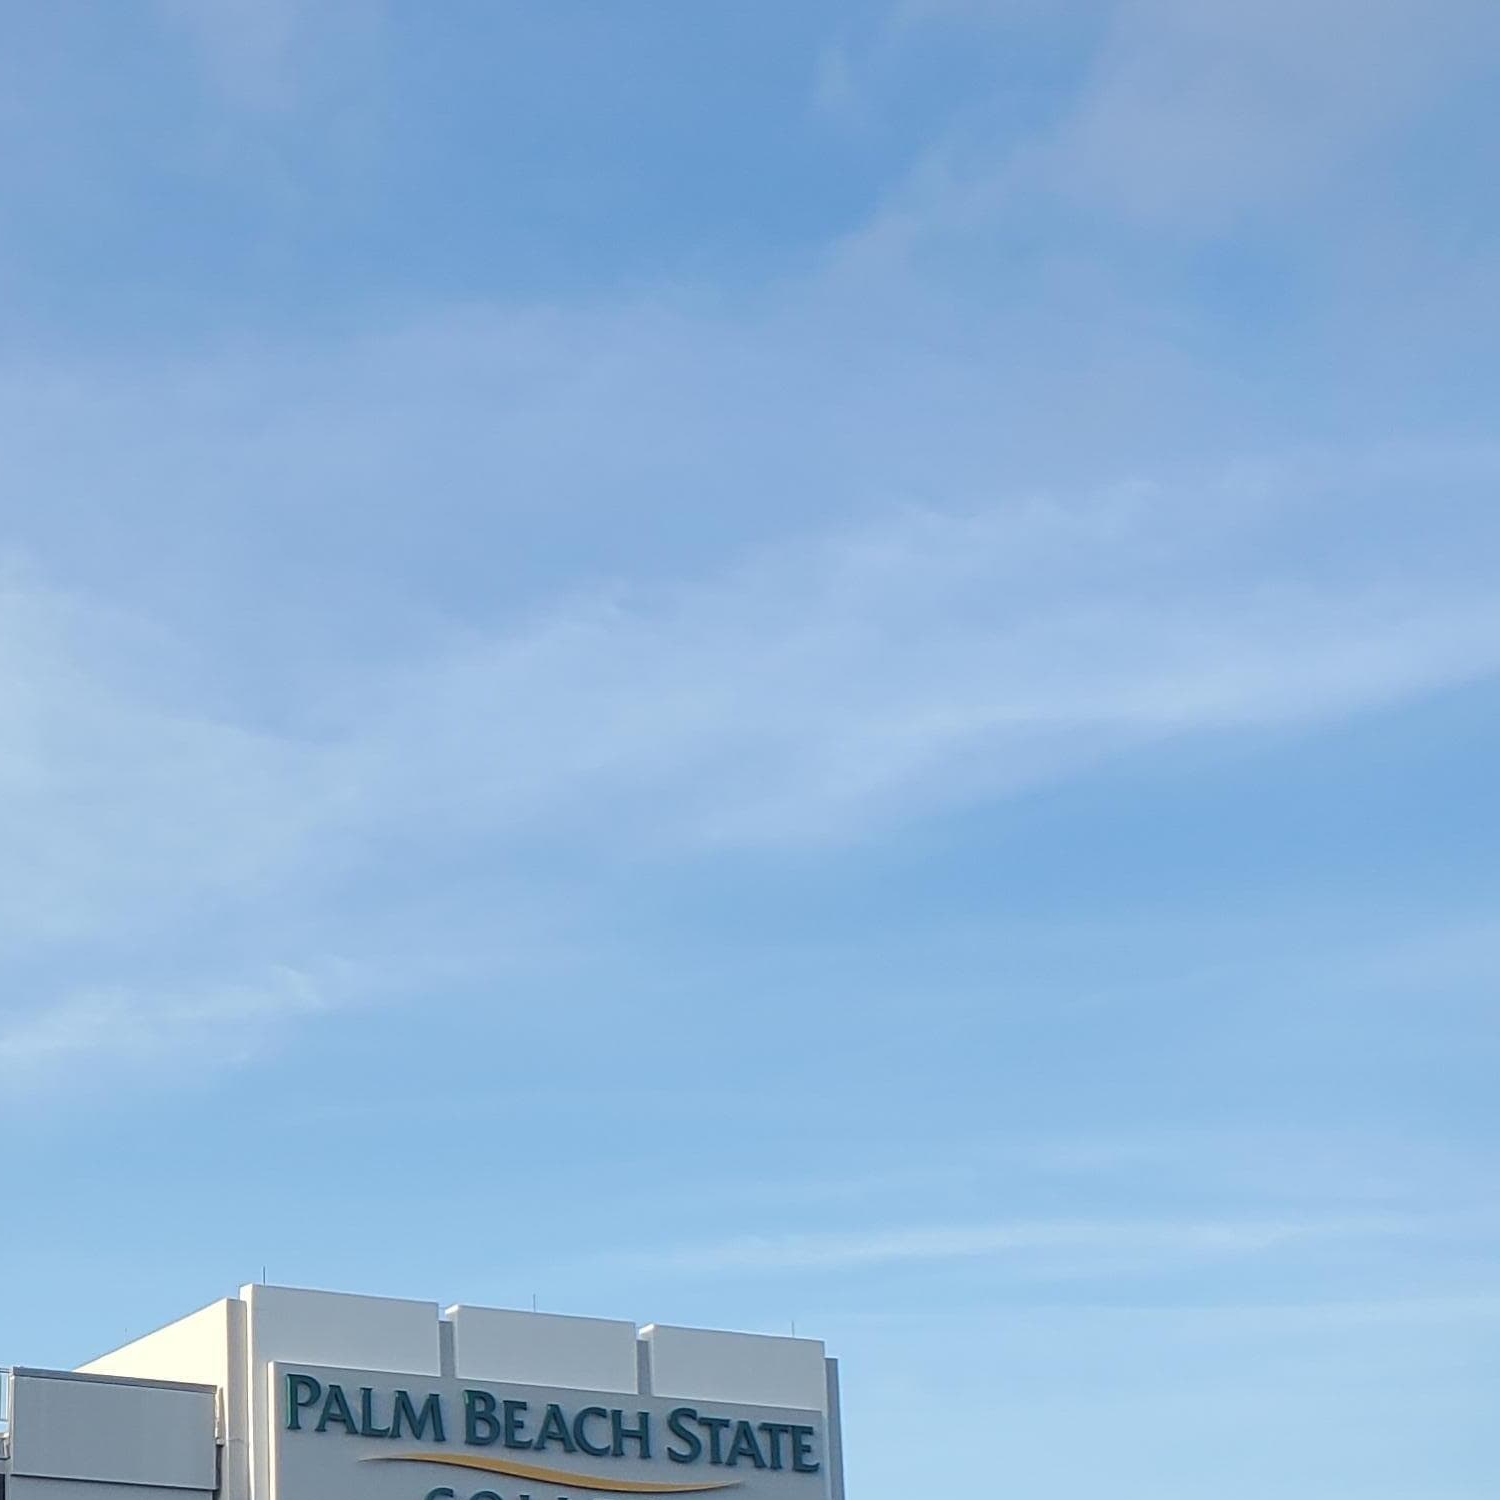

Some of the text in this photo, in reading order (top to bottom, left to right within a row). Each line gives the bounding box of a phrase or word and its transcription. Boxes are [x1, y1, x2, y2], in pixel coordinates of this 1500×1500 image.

[285, 1373, 820, 1473] PALM BEACH STATE
